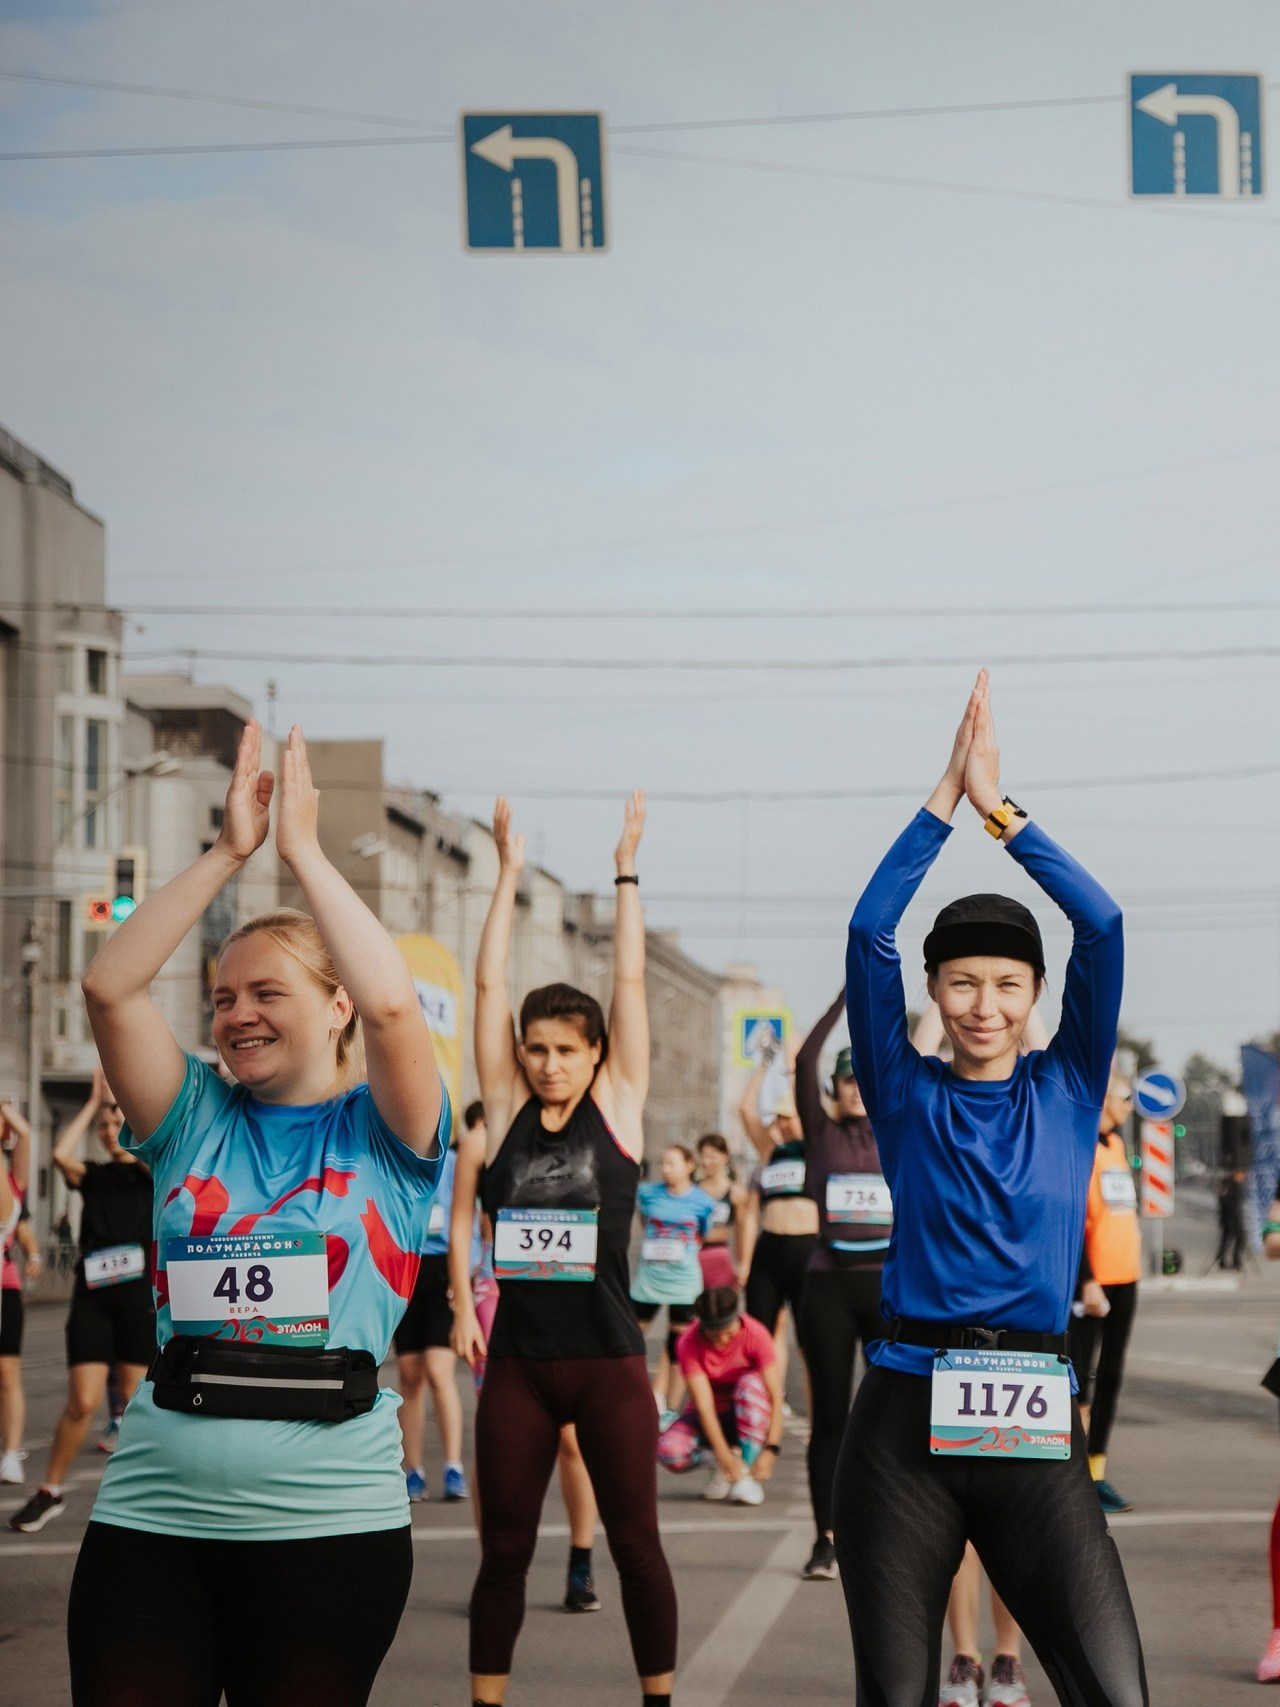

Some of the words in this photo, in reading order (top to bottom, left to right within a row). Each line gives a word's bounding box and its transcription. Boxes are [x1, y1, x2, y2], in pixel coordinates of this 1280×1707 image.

[844, 1190, 878, 1206] 736
[187, 1240, 293, 1253] ПОЛУМАРАФОН
[519, 1228, 572, 1251] 394
[213, 1264, 274, 1304] 48
[229, 1306, 259, 1314] ВЕРА
[276, 1322, 322, 1334] ЭТАЛОН
[955, 1355, 1046, 1369] ПОЛУМАРАФОН
[957, 1382, 1048, 1419] 1176
[979, 1425, 1023, 1453] 26
[1030, 1435, 1066, 1446] ЭТАЛОН
